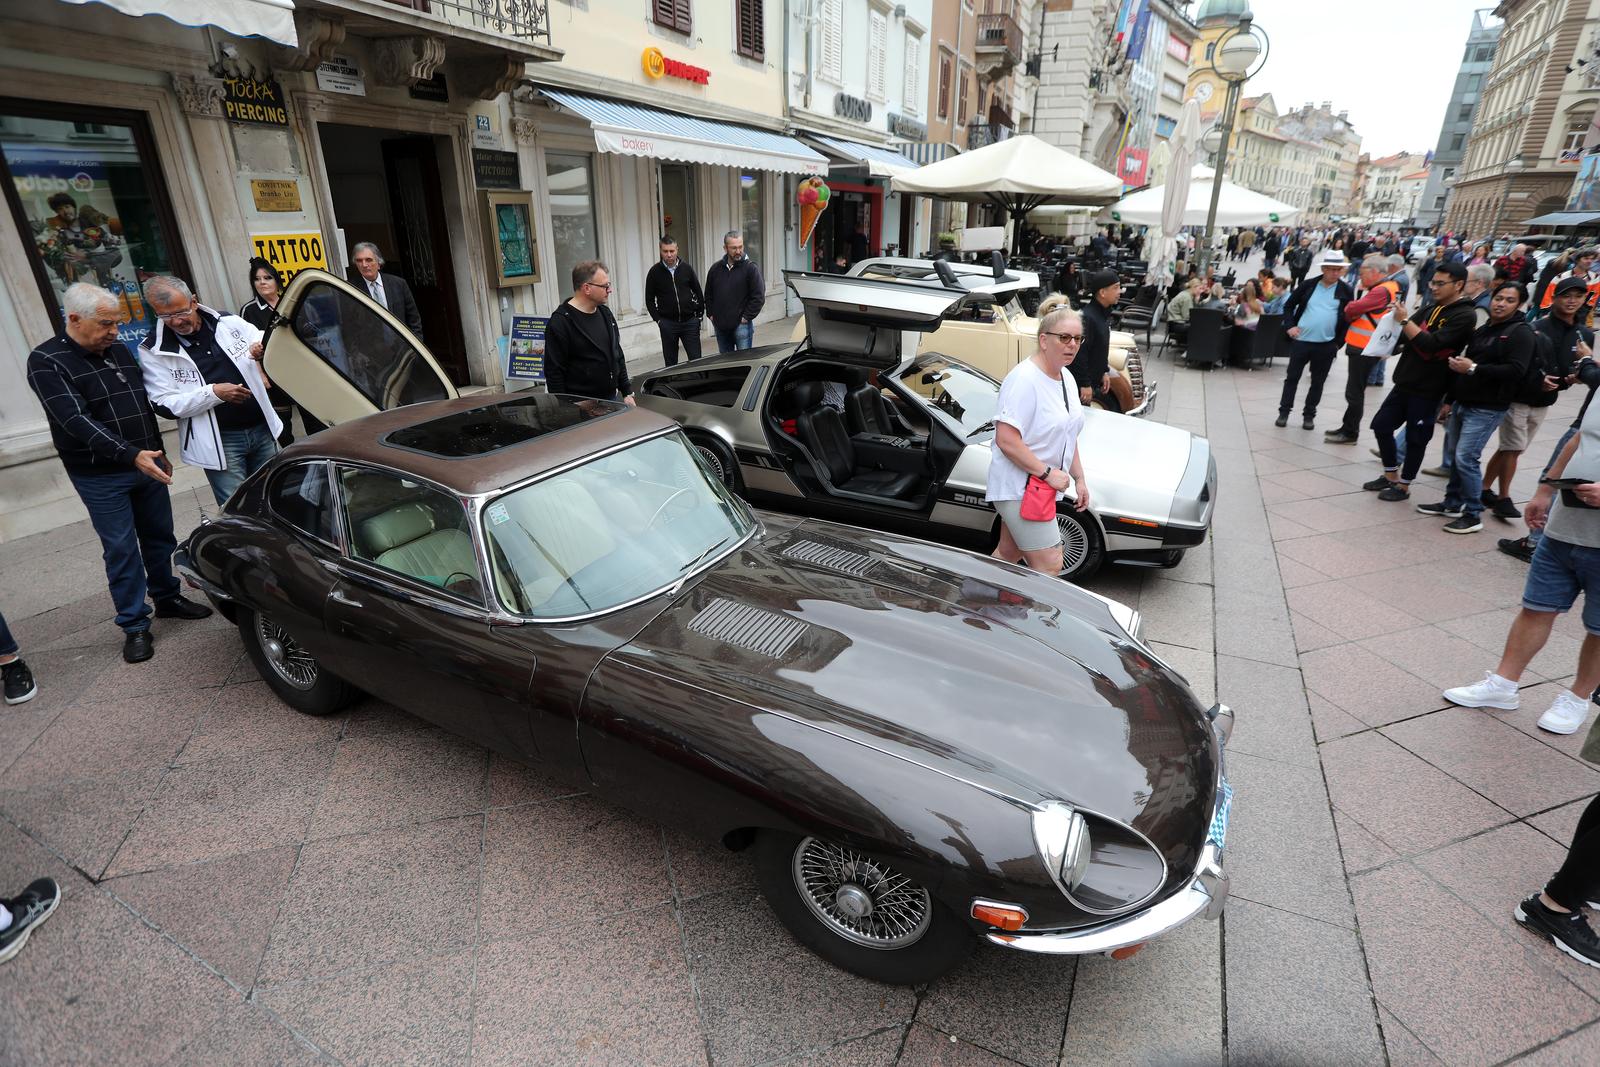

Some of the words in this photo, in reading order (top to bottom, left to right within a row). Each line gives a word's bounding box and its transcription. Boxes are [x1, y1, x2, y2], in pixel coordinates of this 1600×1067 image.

[226, 101, 287, 123] PIERCING
[478, 116, 489, 128] 22
[621, 136, 654, 153] bakery
[255, 237, 322, 264] TATTOO
